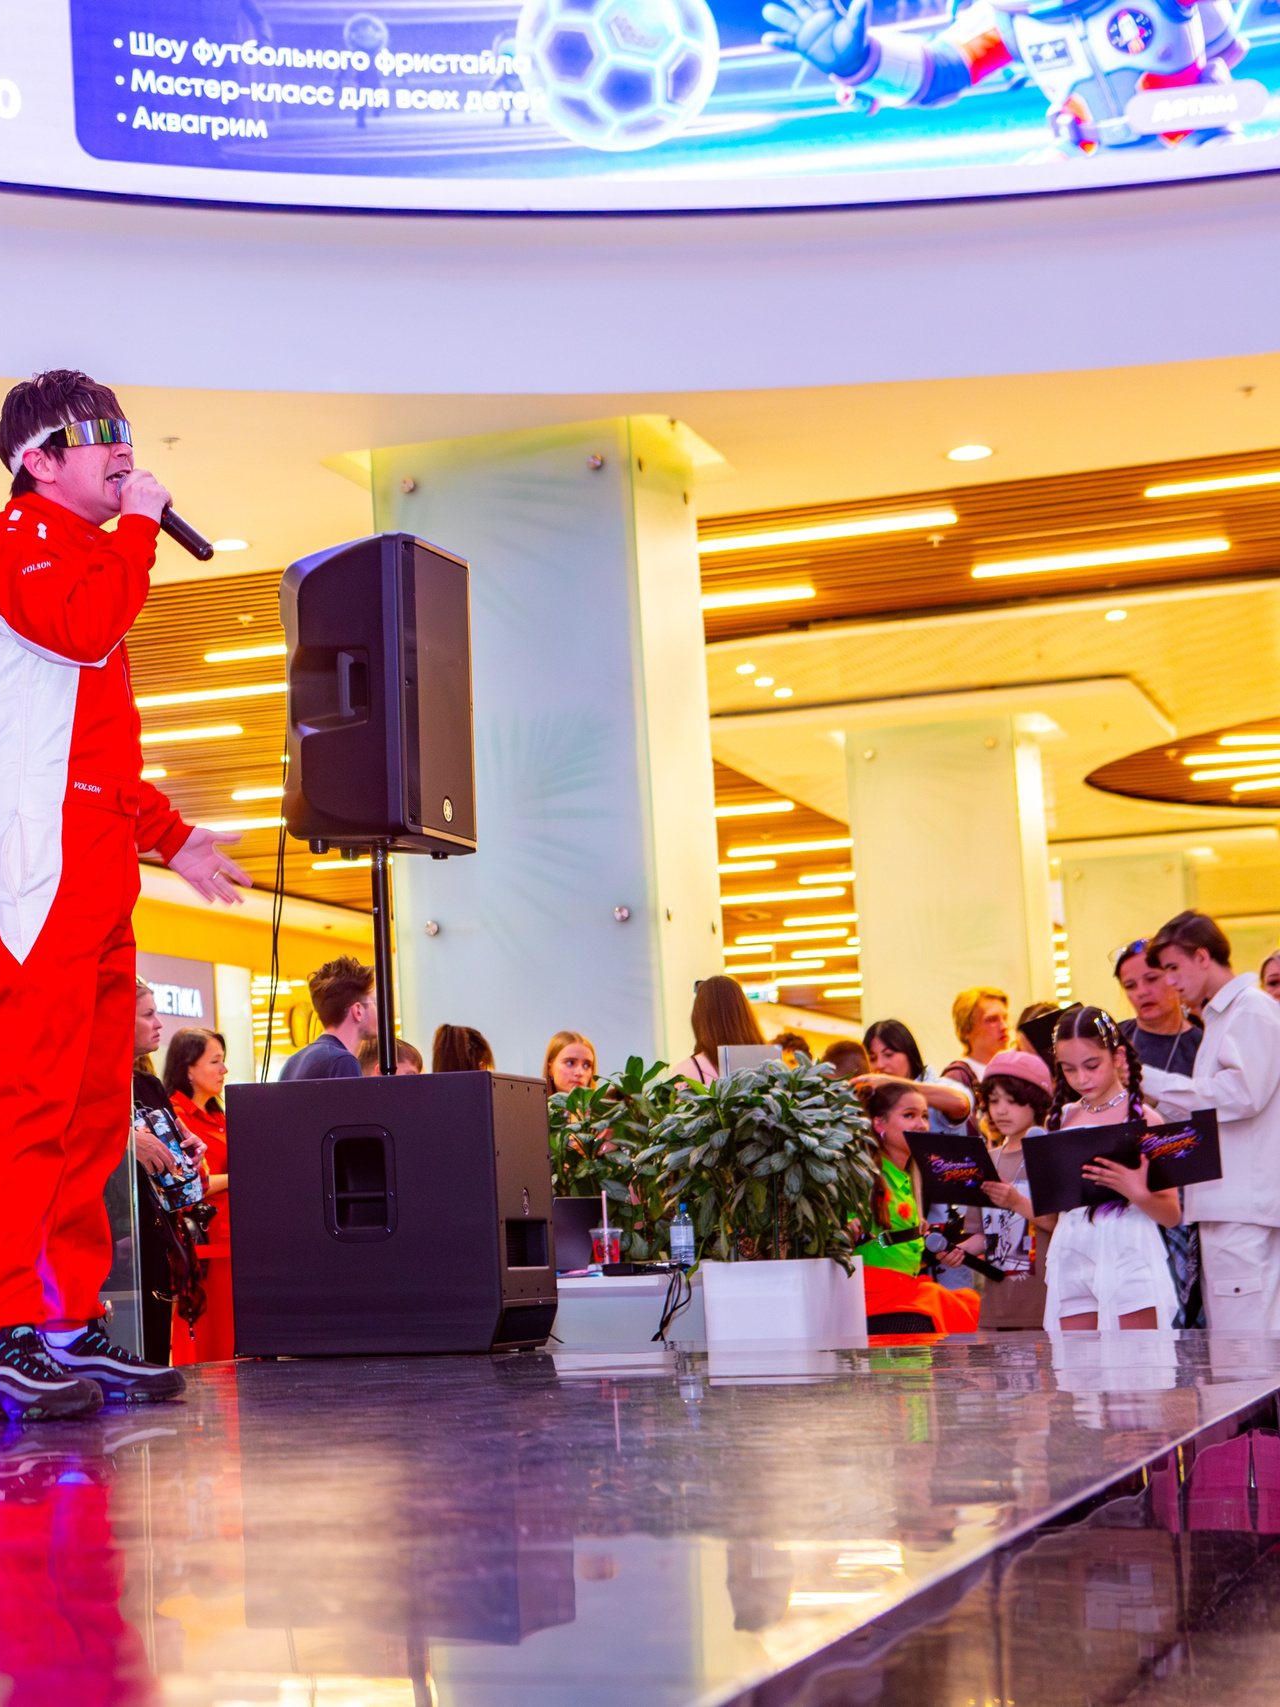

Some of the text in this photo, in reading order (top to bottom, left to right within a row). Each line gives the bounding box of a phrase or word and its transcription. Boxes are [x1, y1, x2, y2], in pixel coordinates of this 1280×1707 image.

[129, 31, 532, 77] Шоу футбольного фристайла
[131, 69, 546, 114] Мастер-класс для всех детей
[132, 106, 268, 140] Аквагрим
[22, 561, 51, 575] VOLSON
[73, 781, 102, 794] VOLSON
